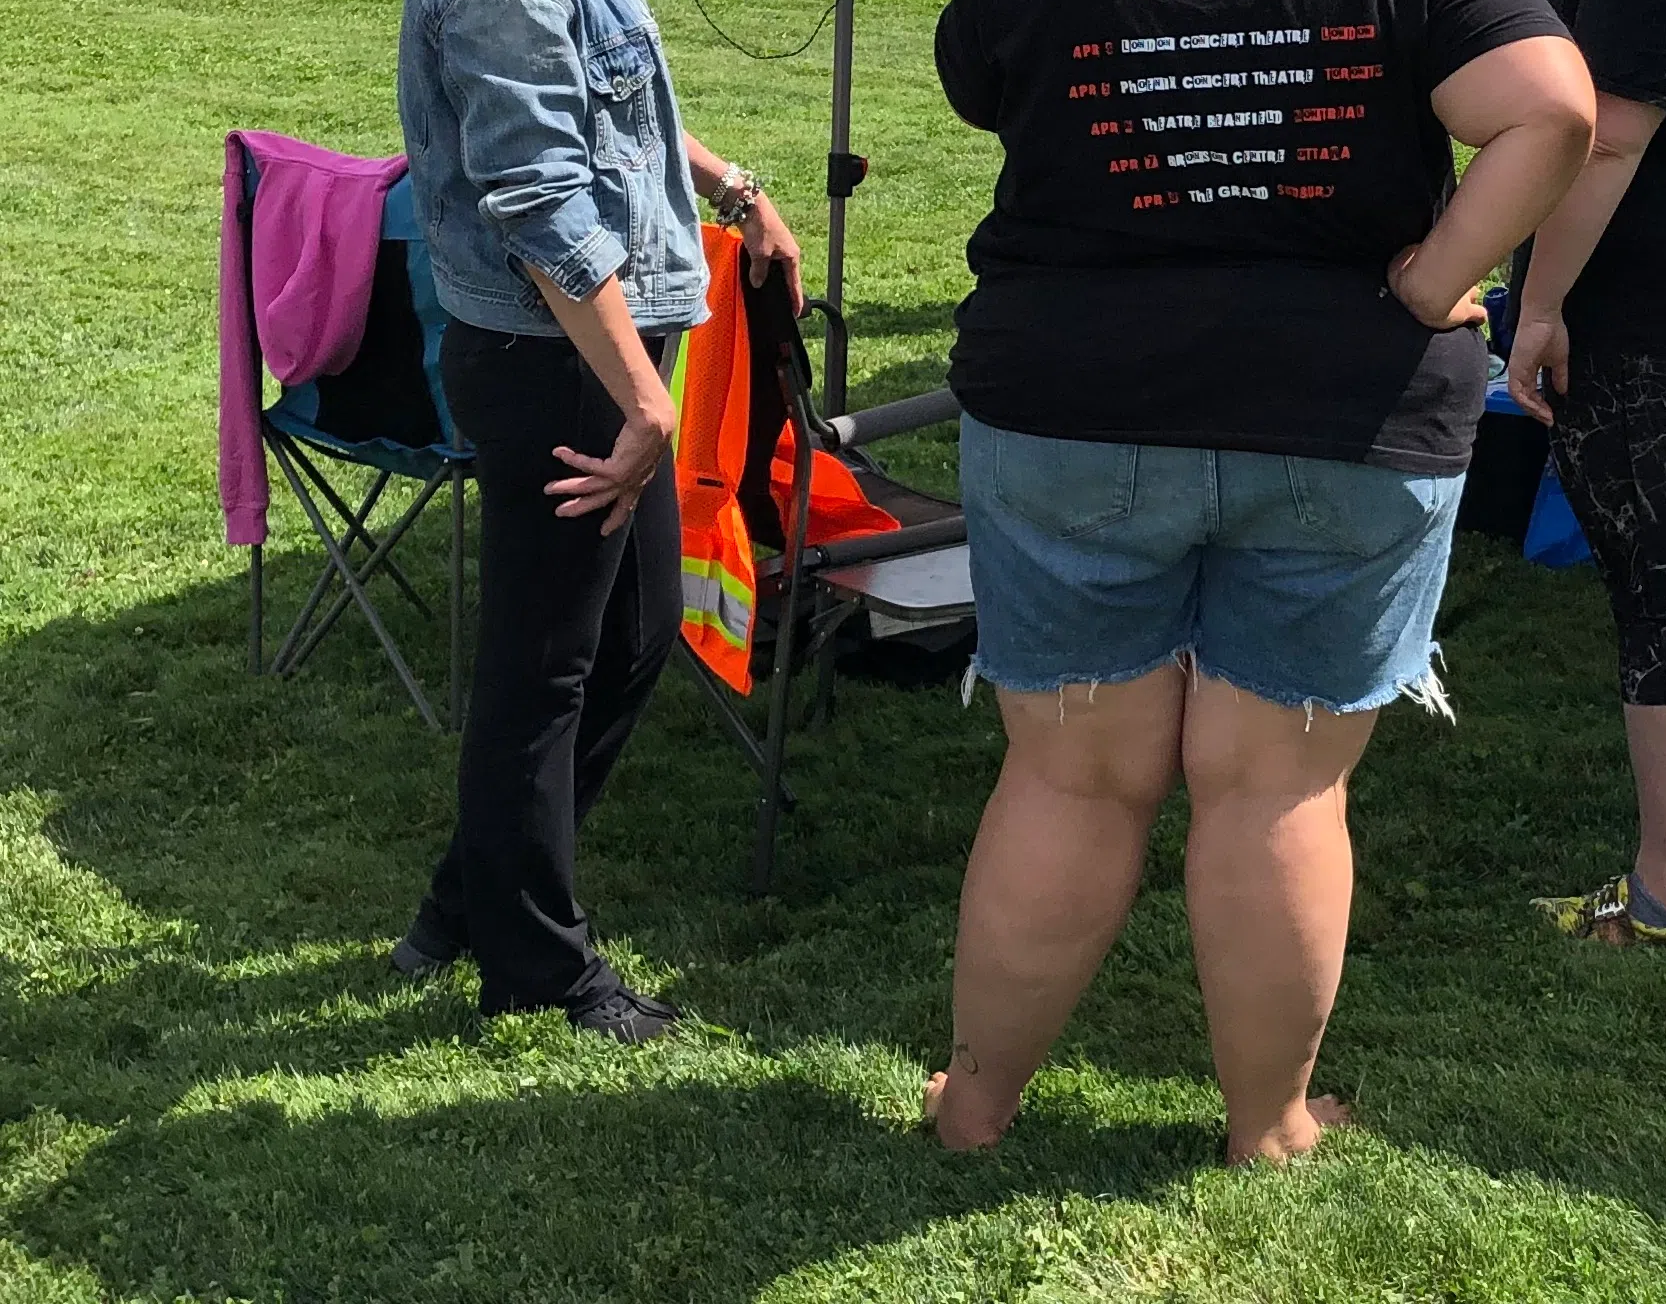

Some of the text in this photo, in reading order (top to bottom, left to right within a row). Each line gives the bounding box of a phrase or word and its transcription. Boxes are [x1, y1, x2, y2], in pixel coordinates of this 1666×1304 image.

[1072, 44, 1100, 59] APR
[1121, 36, 1175, 53] LONDON
[1180, 32, 1245, 49] CONCERT
[1321, 25, 1375, 41] LONDON
[1069, 83, 1097, 98] APR
[1182, 72, 1248, 89] CONCERT
[1324, 64, 1384, 81] TORONTO
[1091, 122, 1119, 136] APR
[1207, 109, 1283, 128] BEANFIELD
[1109, 158, 1139, 173] APR
[1167, 150, 1229, 168] BRONSON
[1233, 149, 1285, 164] CENTRE
[1133, 194, 1164, 209] APR
[1218, 185, 1269, 200] GRAND
[1277, 184, 1335, 199] SUDBURY
